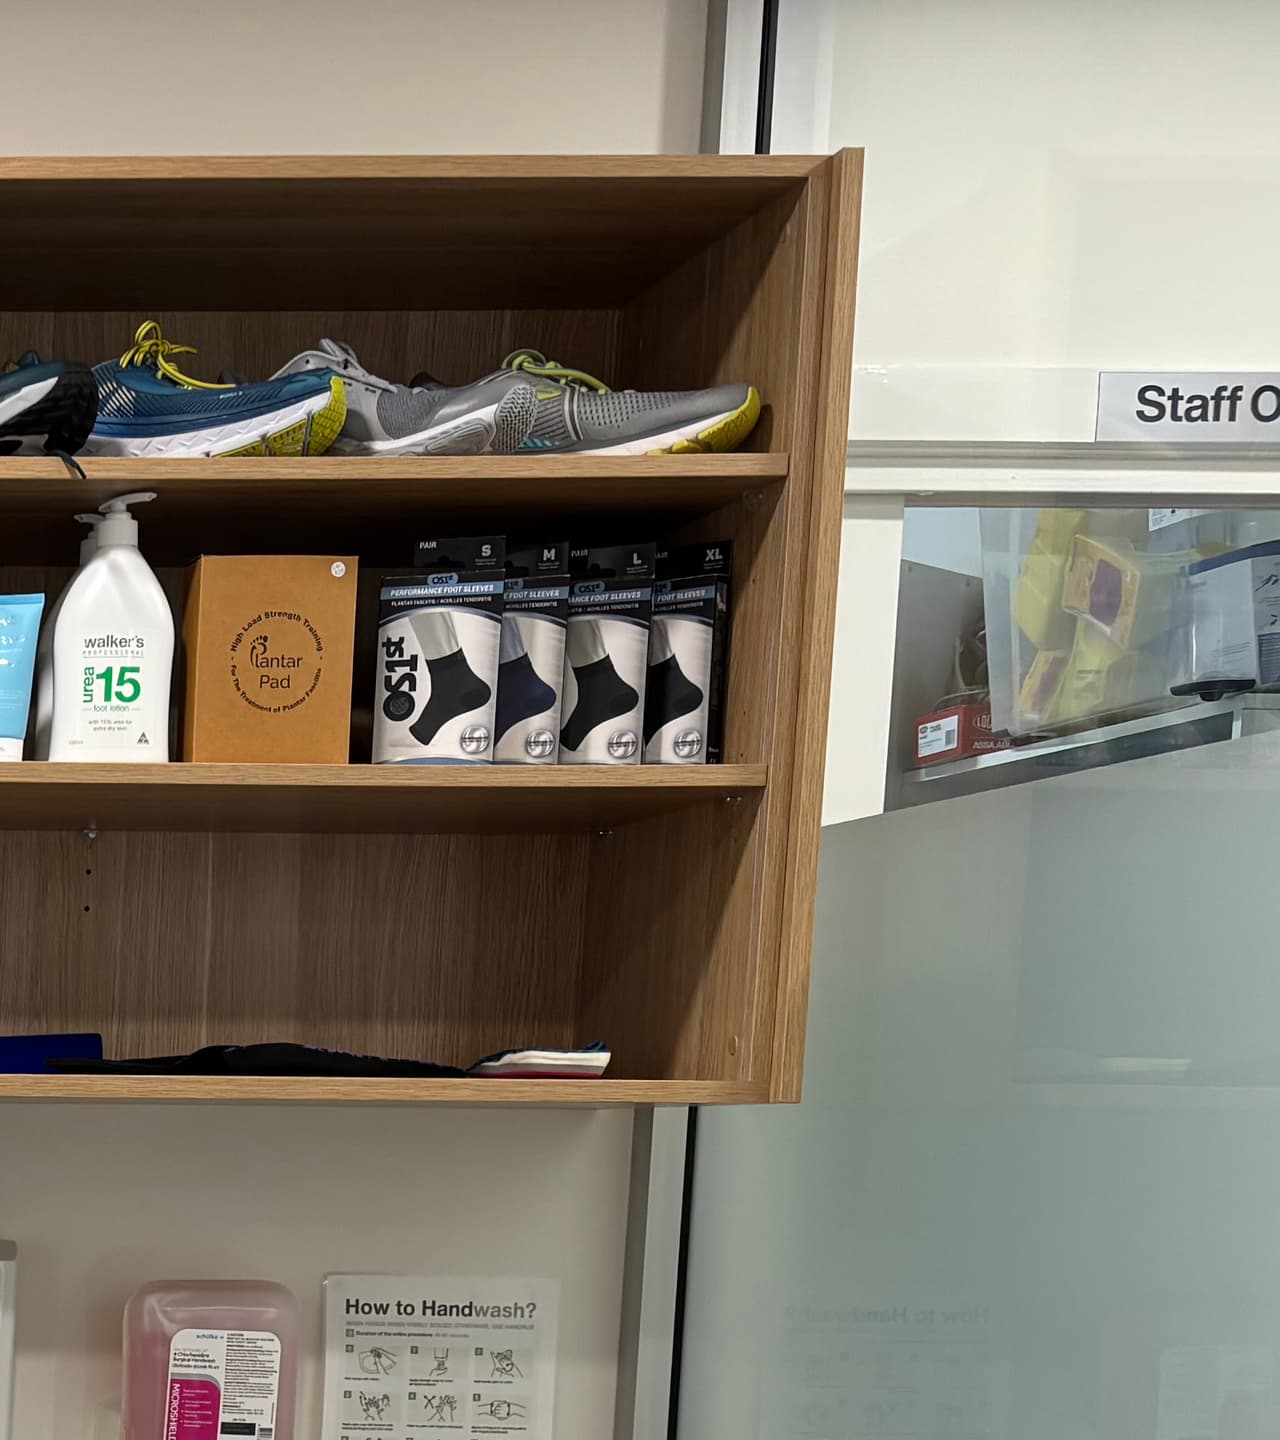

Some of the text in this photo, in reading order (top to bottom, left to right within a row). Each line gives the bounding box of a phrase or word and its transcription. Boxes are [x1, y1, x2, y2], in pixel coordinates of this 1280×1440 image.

[1136, 385, 1241, 423] Staff
[481, 545, 491, 556] S
[543, 548, 556, 561] M
[705, 548, 723, 561] XL
[633, 553, 641, 564] L
[391, 584, 494, 596] PERFORMANCE FOOT SLEEVES
[508, 591, 527, 599] FOOT
[591, 591, 641, 601] FOOT SLEEVES
[231, 611, 323, 652] High Load Strength Training
[84, 634, 145, 649] walker's
[83, 666, 141, 703] urea 15
[259, 674, 290, 689] Pad
[382, 635, 418, 722] OS1st
[345, 1299, 537, 1318] How to Handwash?
